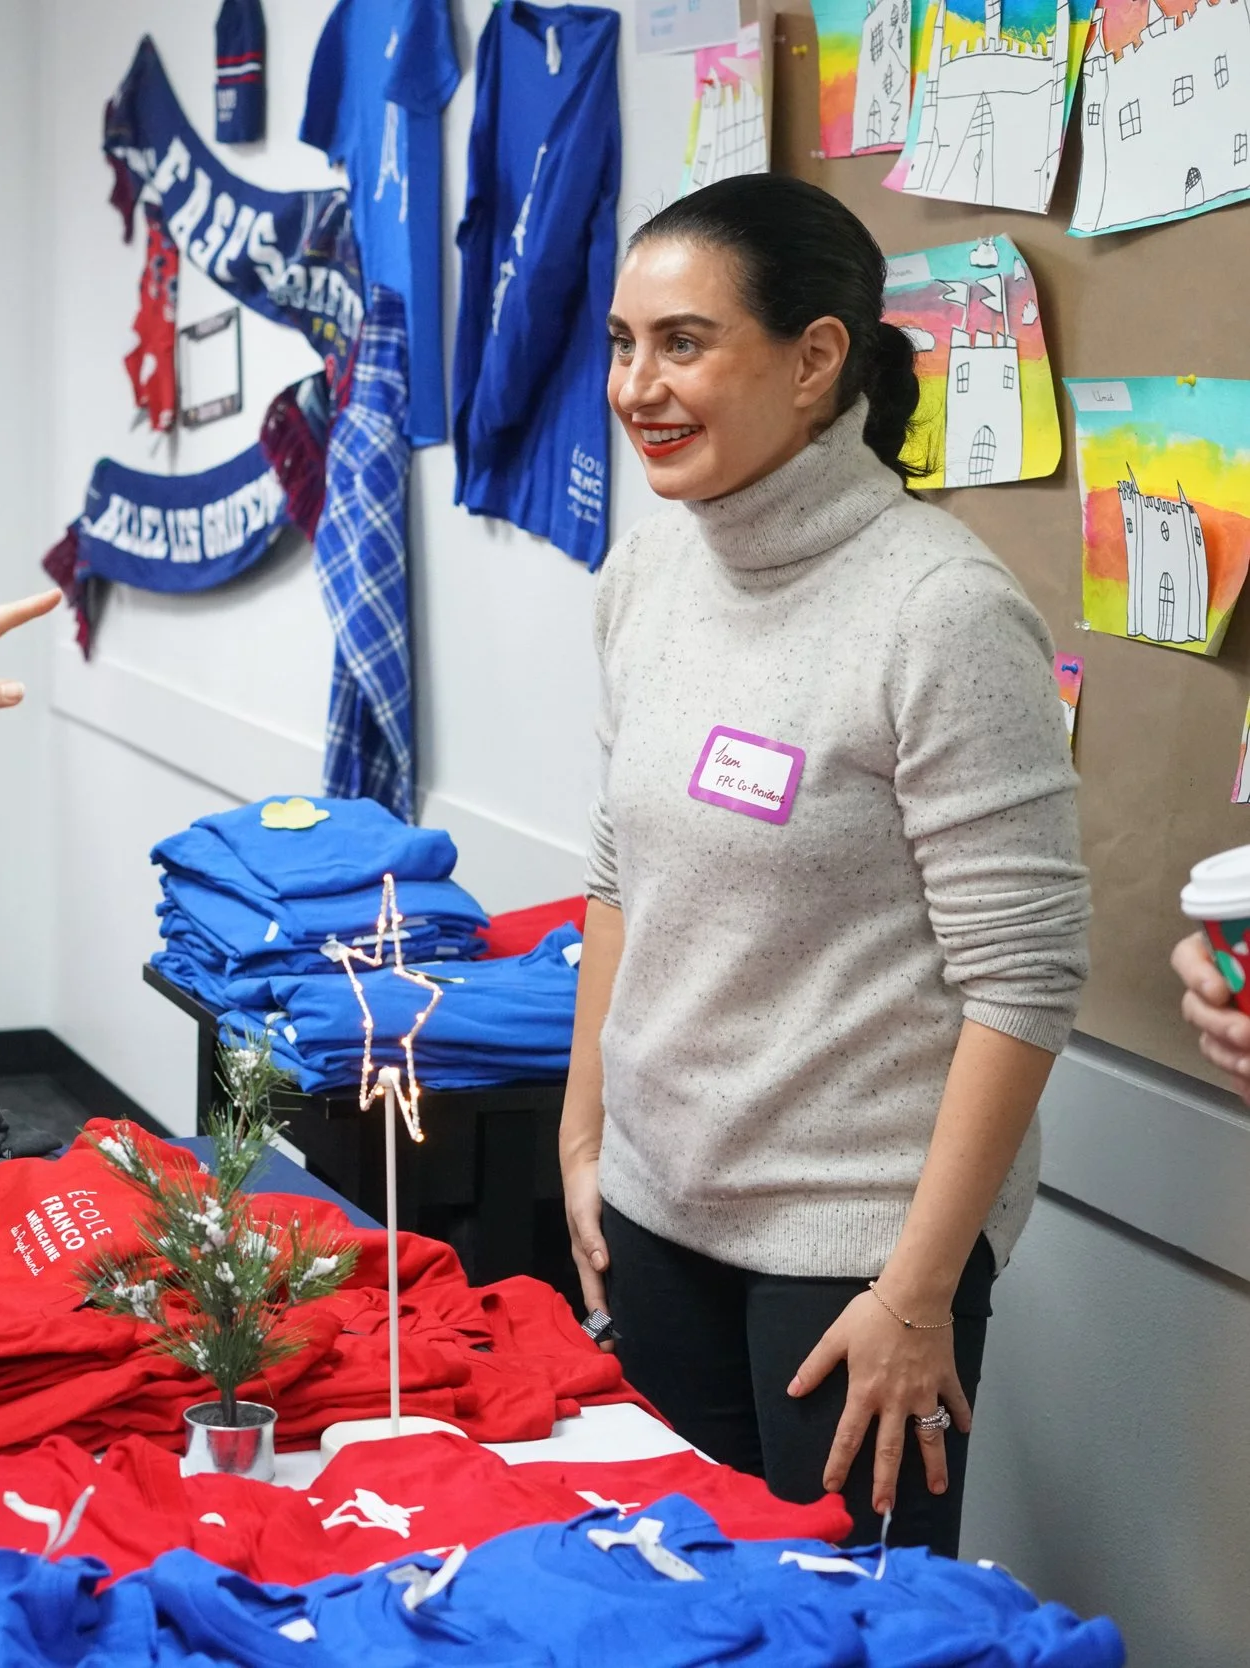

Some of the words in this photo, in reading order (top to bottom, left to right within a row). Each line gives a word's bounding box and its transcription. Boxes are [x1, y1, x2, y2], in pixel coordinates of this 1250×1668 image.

[26, 1209, 61, 1263] AMÉRICAINE
[40, 1195, 86, 1251] FRANCO
[67, 1190, 113, 1240] ÉCOLE
